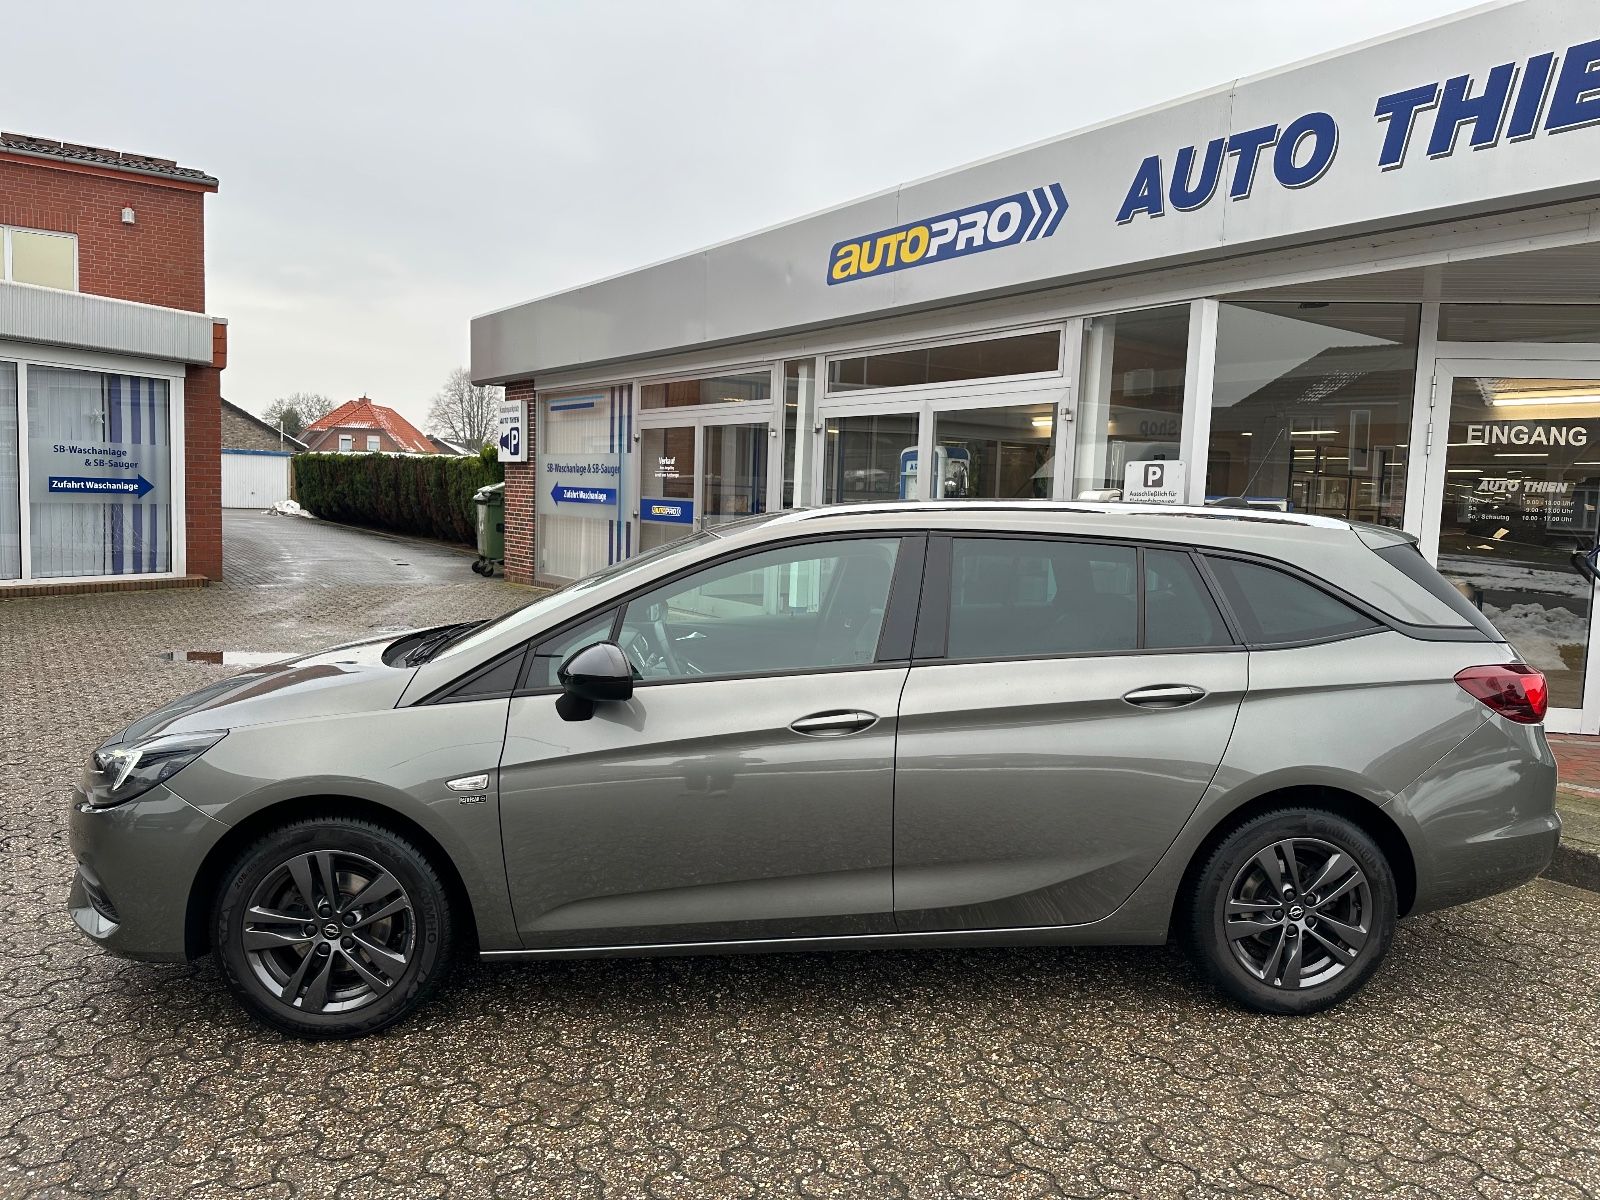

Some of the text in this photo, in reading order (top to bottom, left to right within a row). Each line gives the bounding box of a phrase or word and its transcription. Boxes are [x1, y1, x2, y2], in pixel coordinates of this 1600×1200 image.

[1115, 39, 1600, 226] AUTO THIE
[1466, 425, 1587, 446] EINGANG
[53, 445, 127, 458] SB-Waschanlage
[84, 459, 138, 470] & SB-Sauger
[547, 463, 620, 476] SB-Waschanlage & SB-Sauger
[1147, 466, 1162, 486] P
[52, 480, 138, 492] Zufahrt Waschanlage
[1477, 480, 1569, 493] AUTO THIEN
[563, 490, 607, 502] Zufahrt Waschanlage
